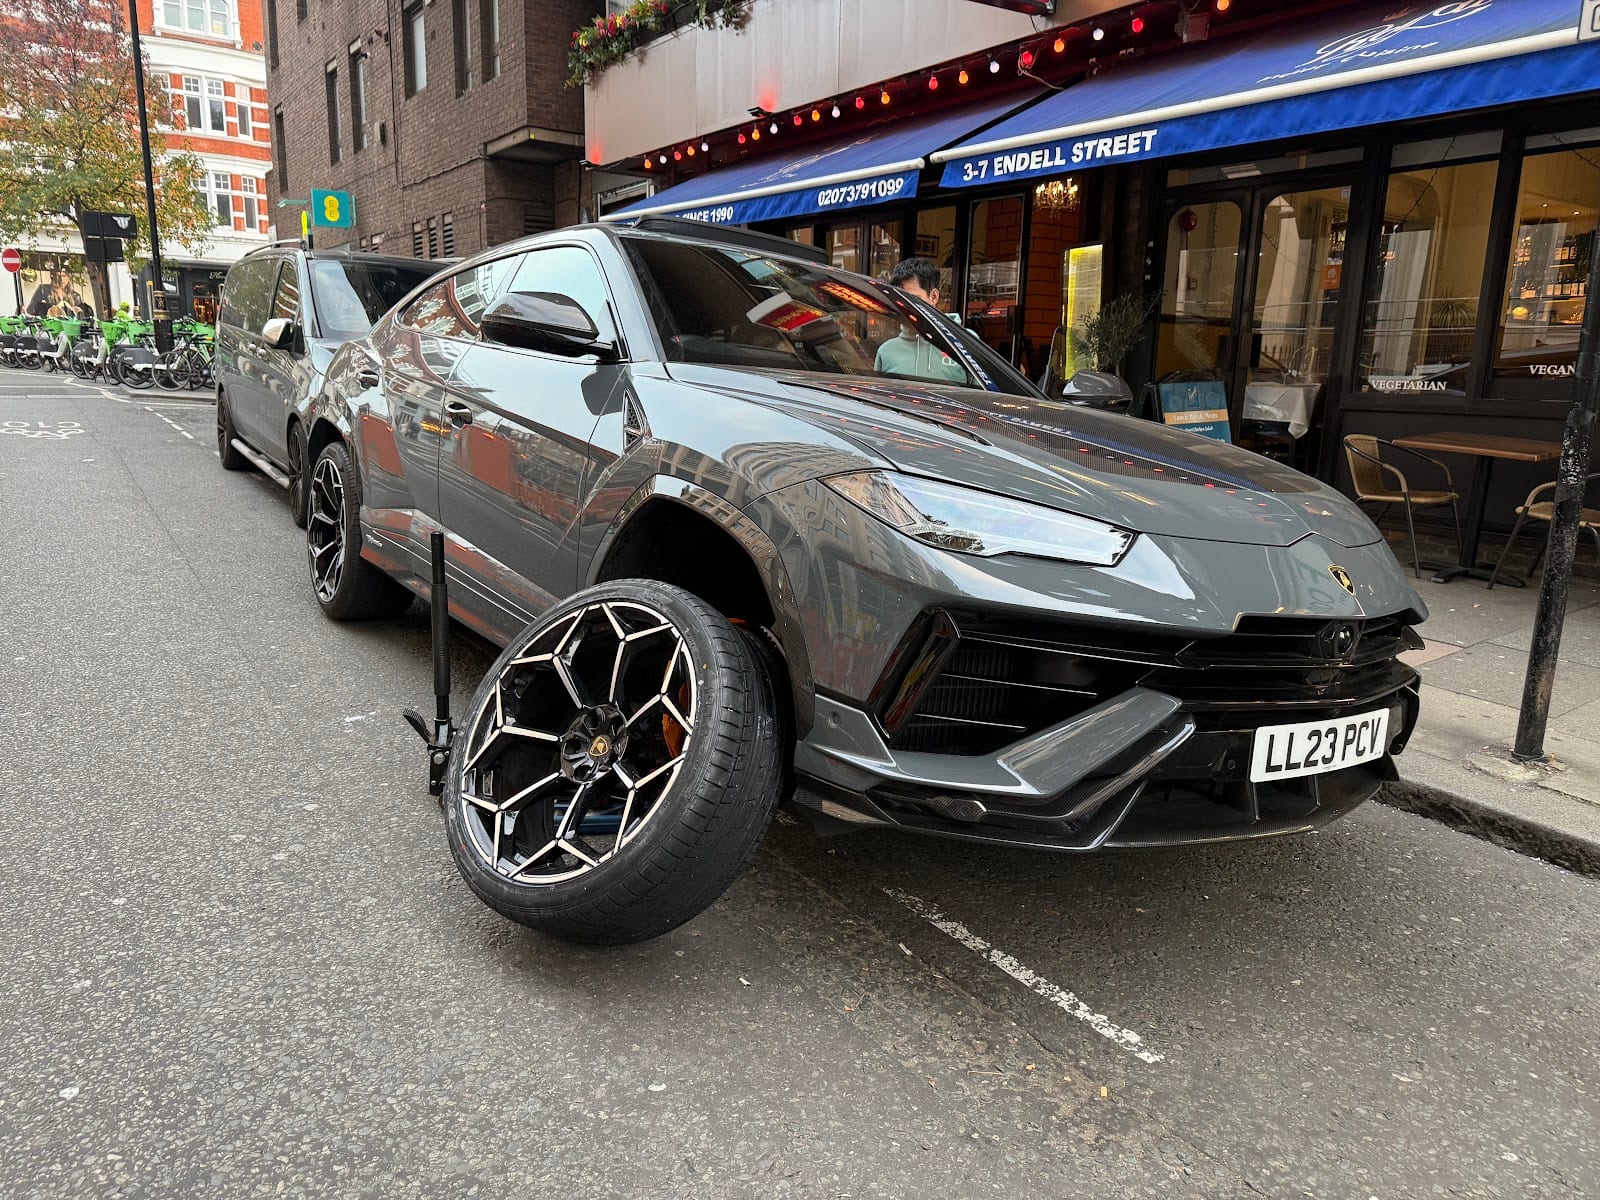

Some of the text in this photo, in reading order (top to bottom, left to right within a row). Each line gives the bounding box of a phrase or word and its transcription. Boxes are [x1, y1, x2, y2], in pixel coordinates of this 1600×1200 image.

[962, 129, 1158, 182] 3-7 ENDELL STREET
[817, 177, 904, 207] 02073791099
[710, 206, 734, 222] 1990
[1529, 364, 1576, 376] VEGAN
[1371, 379, 1448, 392] VEGETARIAN
[1265, 717, 1382, 773] LL23 PCV
